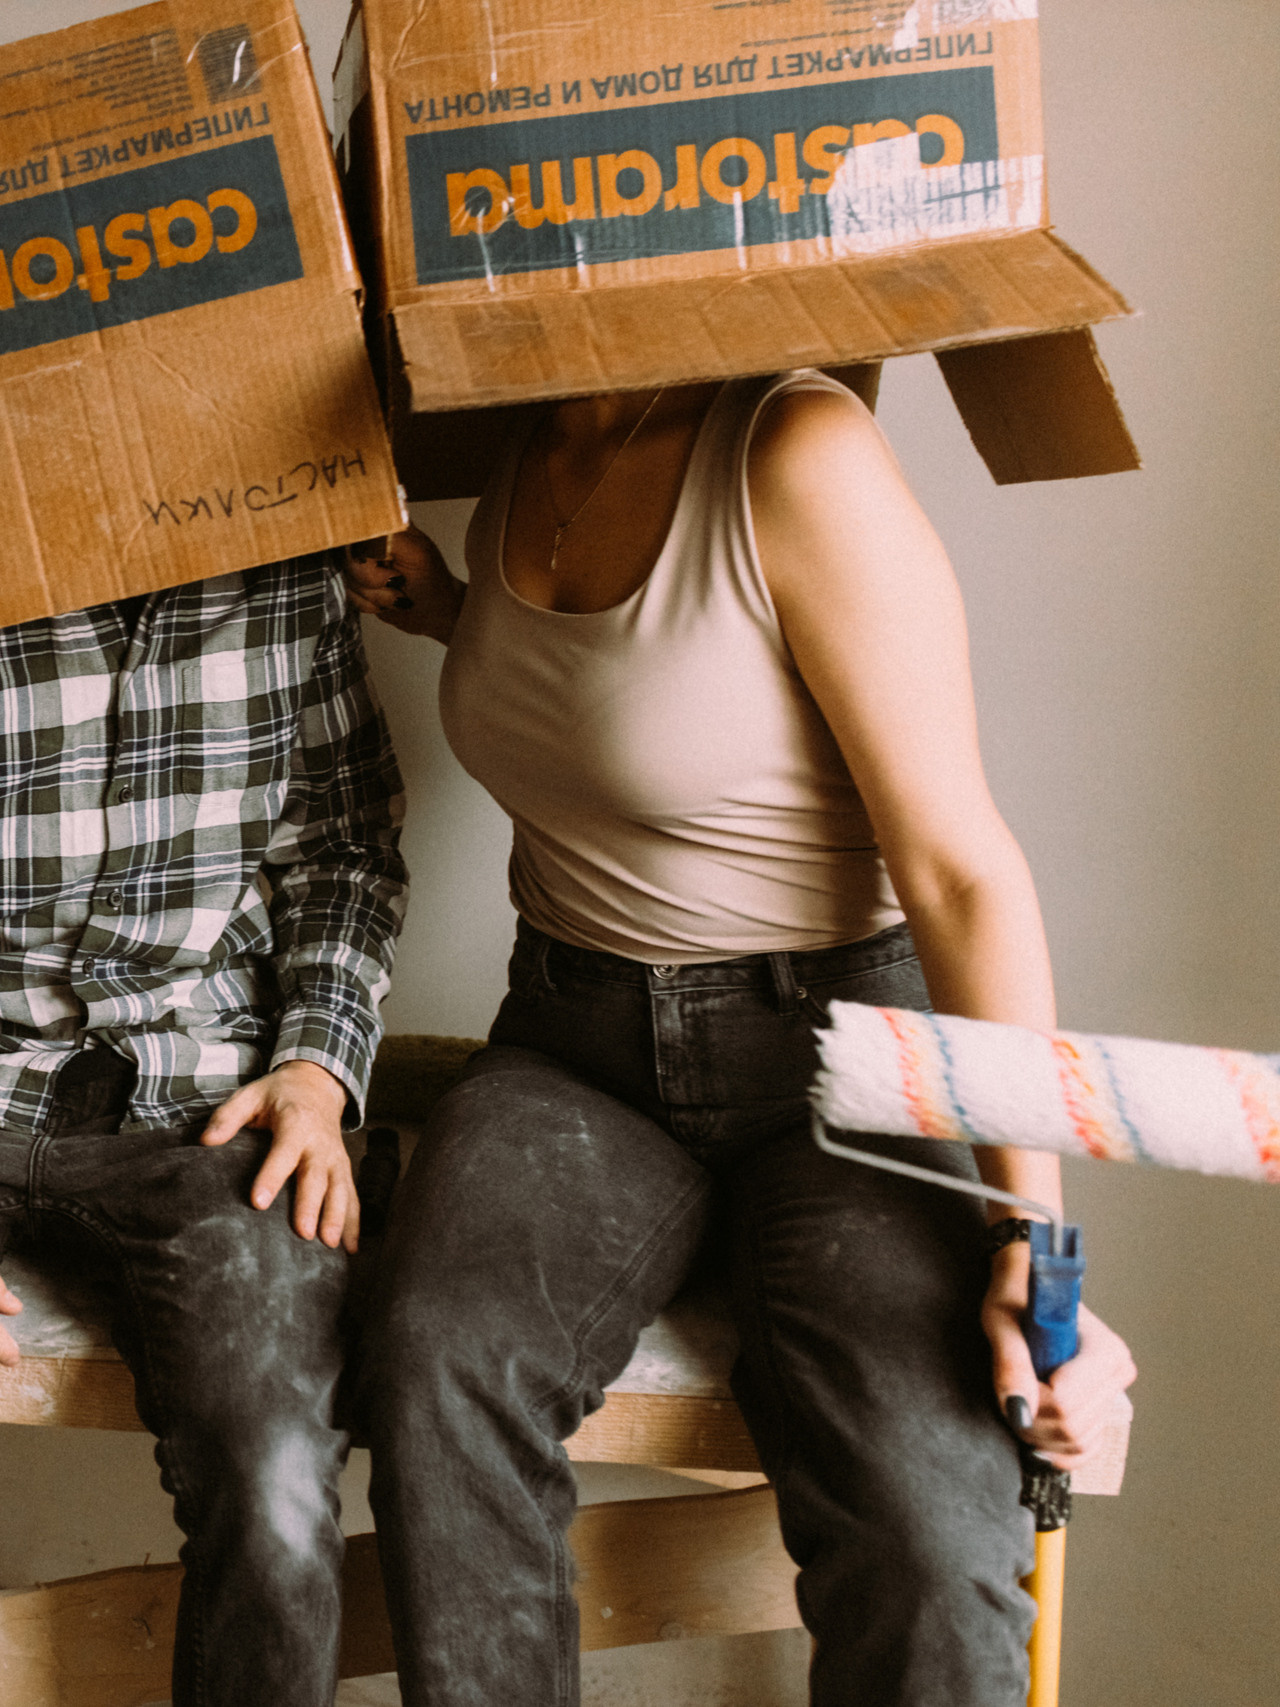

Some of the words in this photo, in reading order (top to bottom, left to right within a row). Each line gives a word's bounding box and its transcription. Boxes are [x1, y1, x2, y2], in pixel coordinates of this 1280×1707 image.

[693, 53, 758, 88] ДЛЯ
[767, 31, 994, 80] ГИПЕРМАРКЕТ
[562, 79, 582, 104] И
[591, 63, 683, 100] ДОМА
[404, 83, 551, 124] РЕМОНТА
[60, 101, 271, 179] ГИПЕРМАРКЕТ
